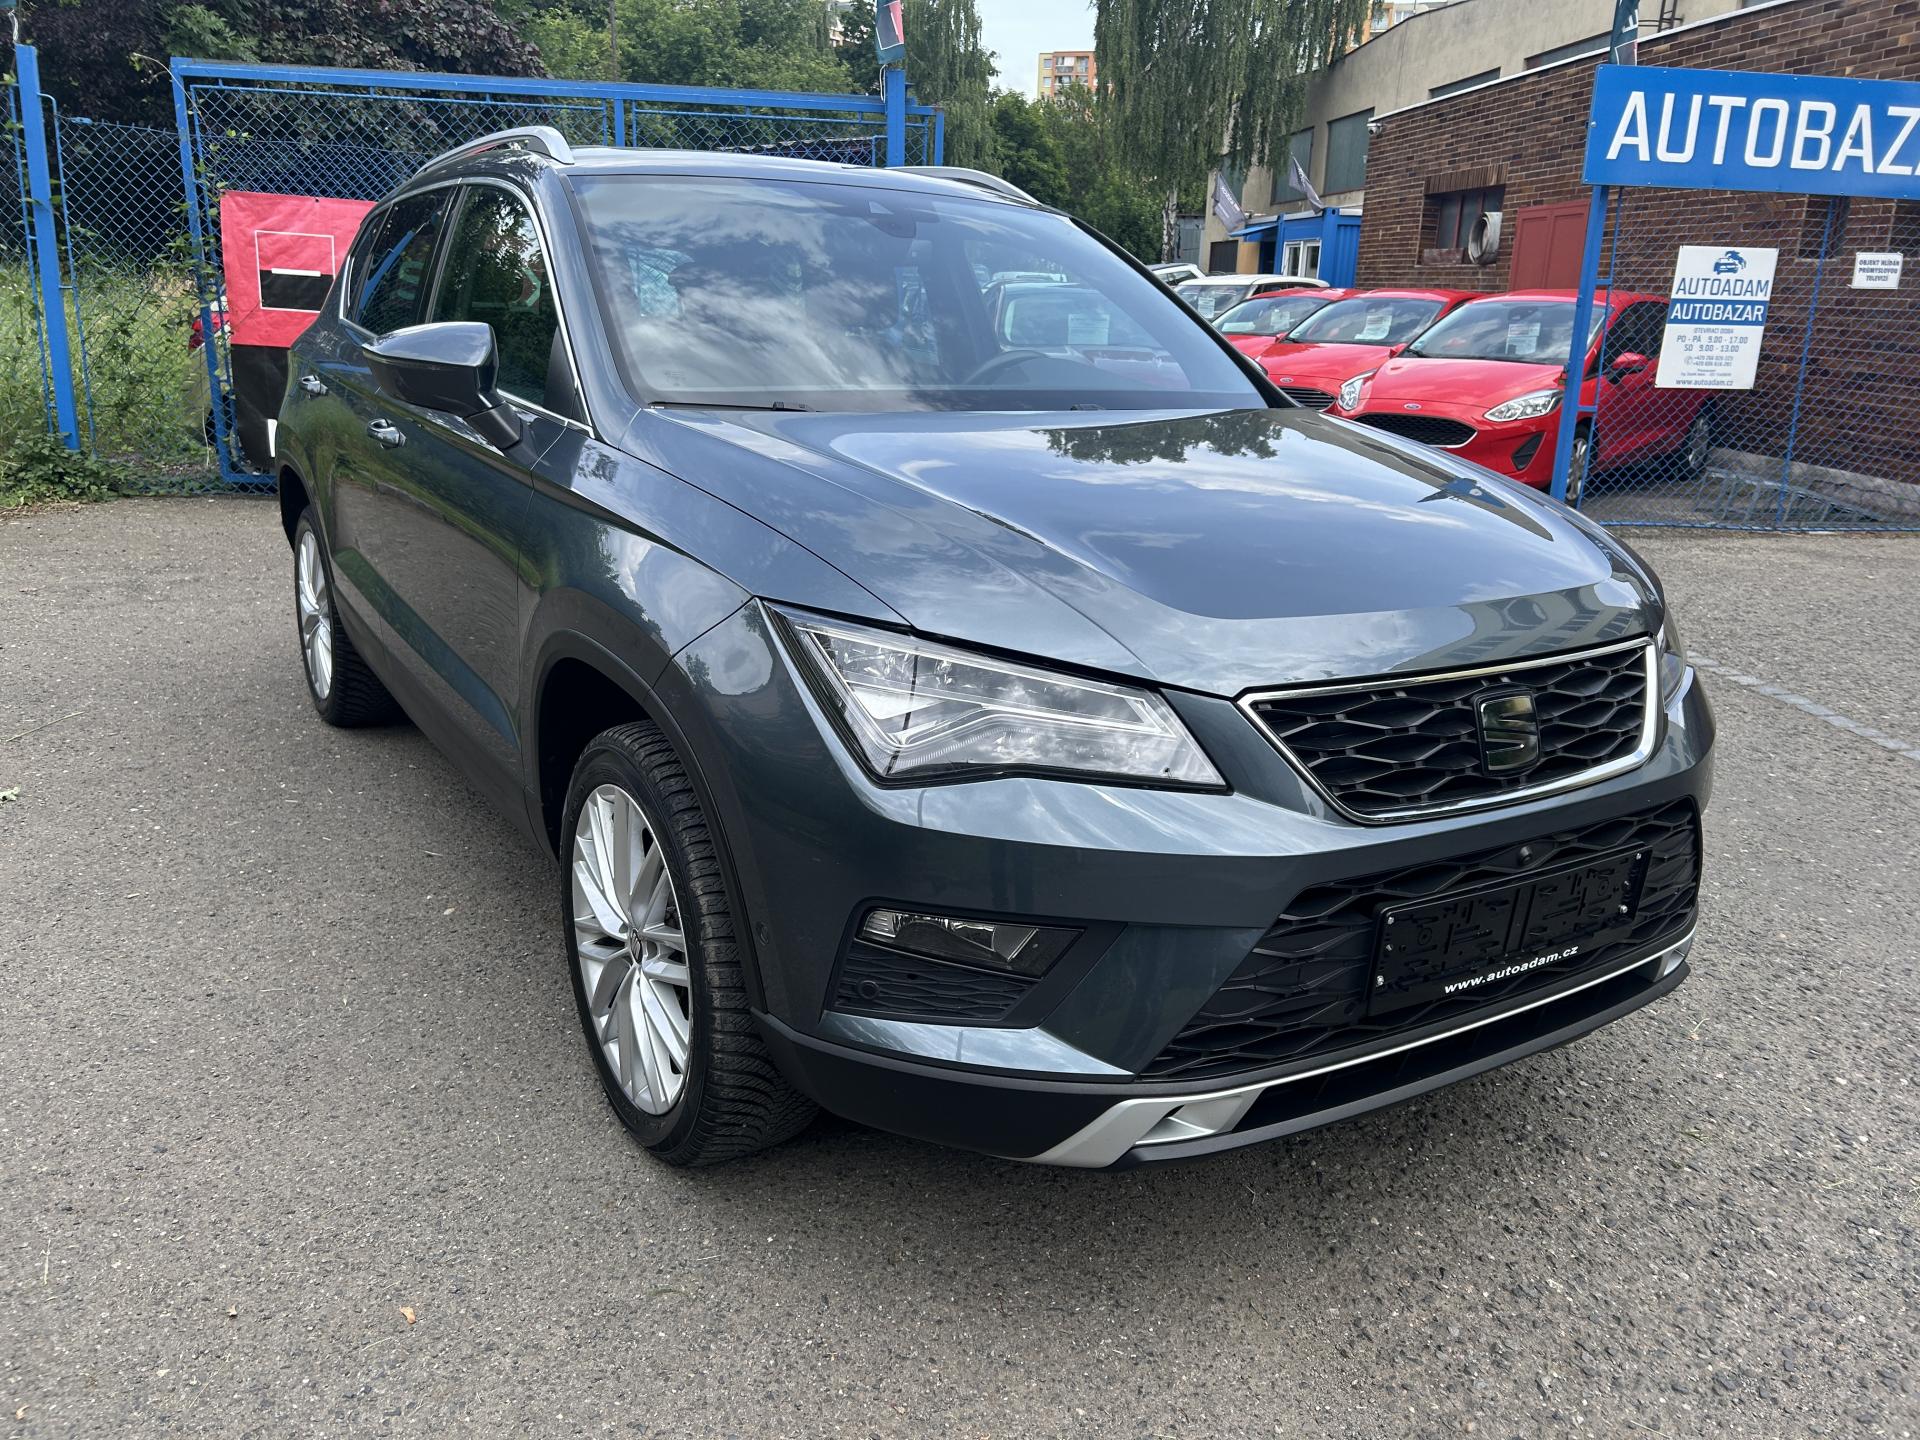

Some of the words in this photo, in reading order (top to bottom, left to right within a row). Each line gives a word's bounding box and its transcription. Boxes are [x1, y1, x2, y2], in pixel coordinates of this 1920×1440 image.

[1606, 91, 1920, 176] AUTOBAZ
[1675, 277, 1770, 297] AUTOADAM
[1670, 303, 1765, 322] AUTOBAZAR
[1676, 335, 1687, 343] PO
[1684, 344, 1694, 352] SO
[1444, 944, 1579, 994] www.autoadam.cz
